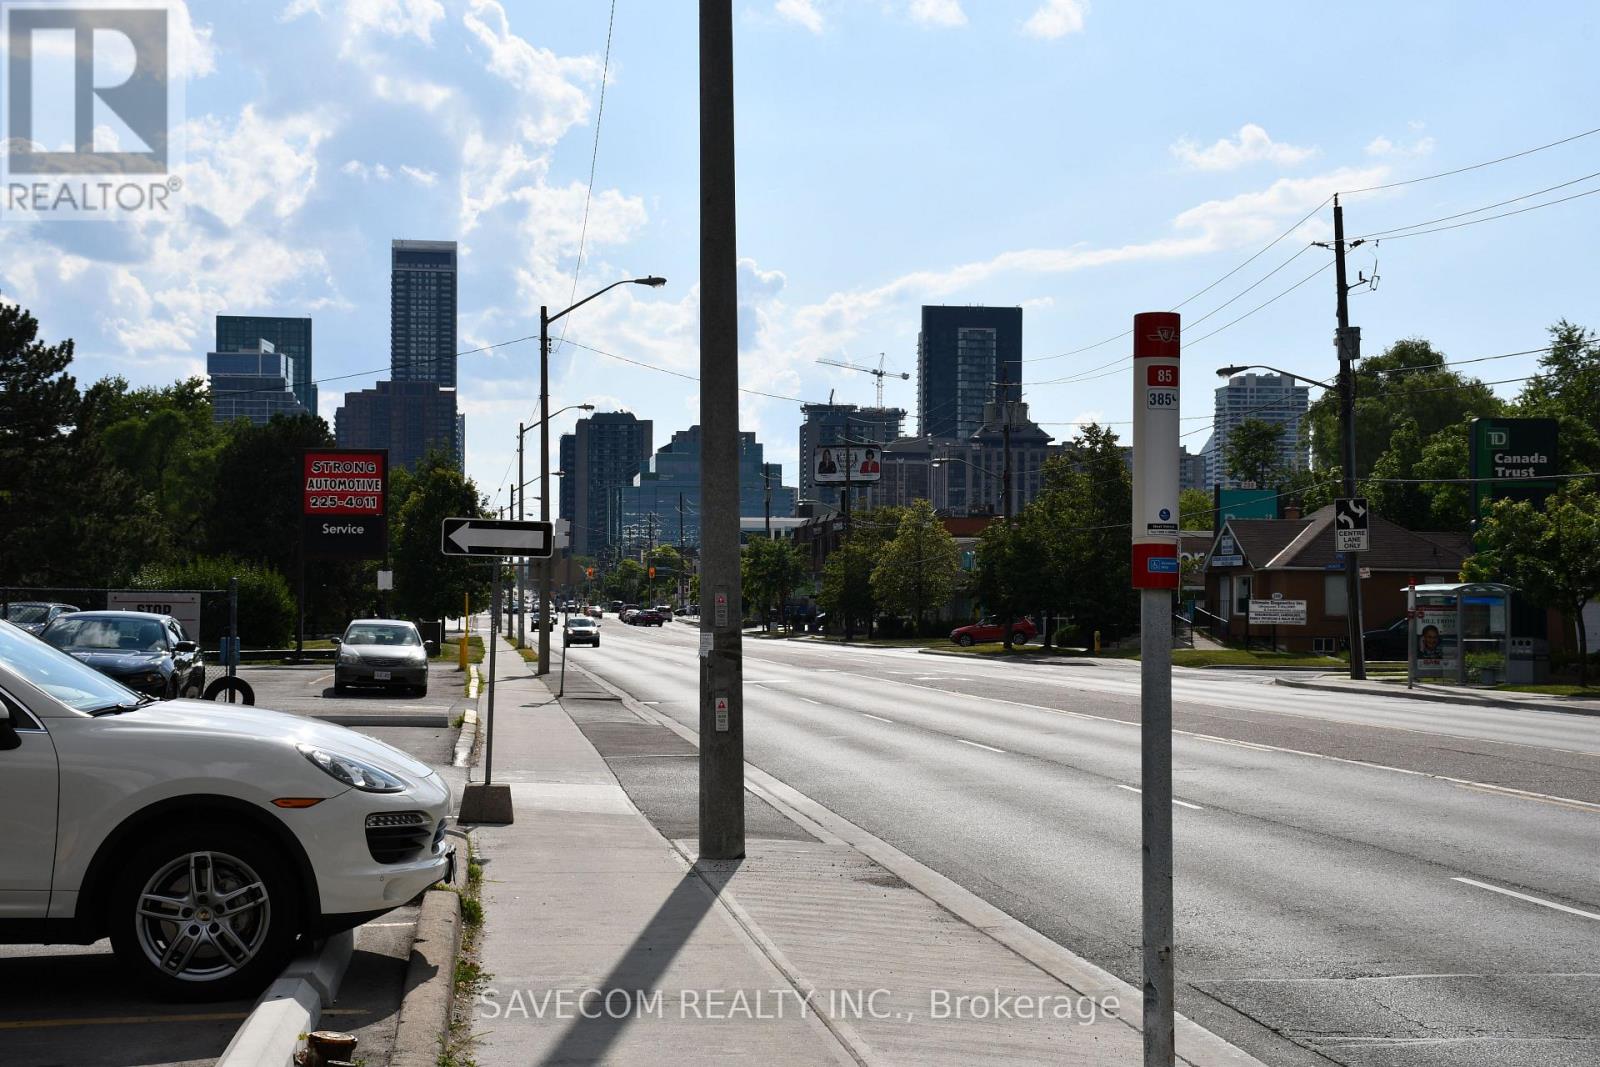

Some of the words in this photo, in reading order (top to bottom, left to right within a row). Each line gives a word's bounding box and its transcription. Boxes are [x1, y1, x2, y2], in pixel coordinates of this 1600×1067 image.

[1157, 369, 1173, 383] 85
[1149, 392, 1172, 406] 385
[1487, 431, 1507, 446] TD
[1494, 452, 1548, 464] Canada
[311, 460, 377, 474] STRONG
[1494, 466, 1536, 477] Trust
[305, 477, 382, 492] AUTOMOTIVE
[309, 495, 378, 509] 225-4011
[322, 523, 365, 535] Service
